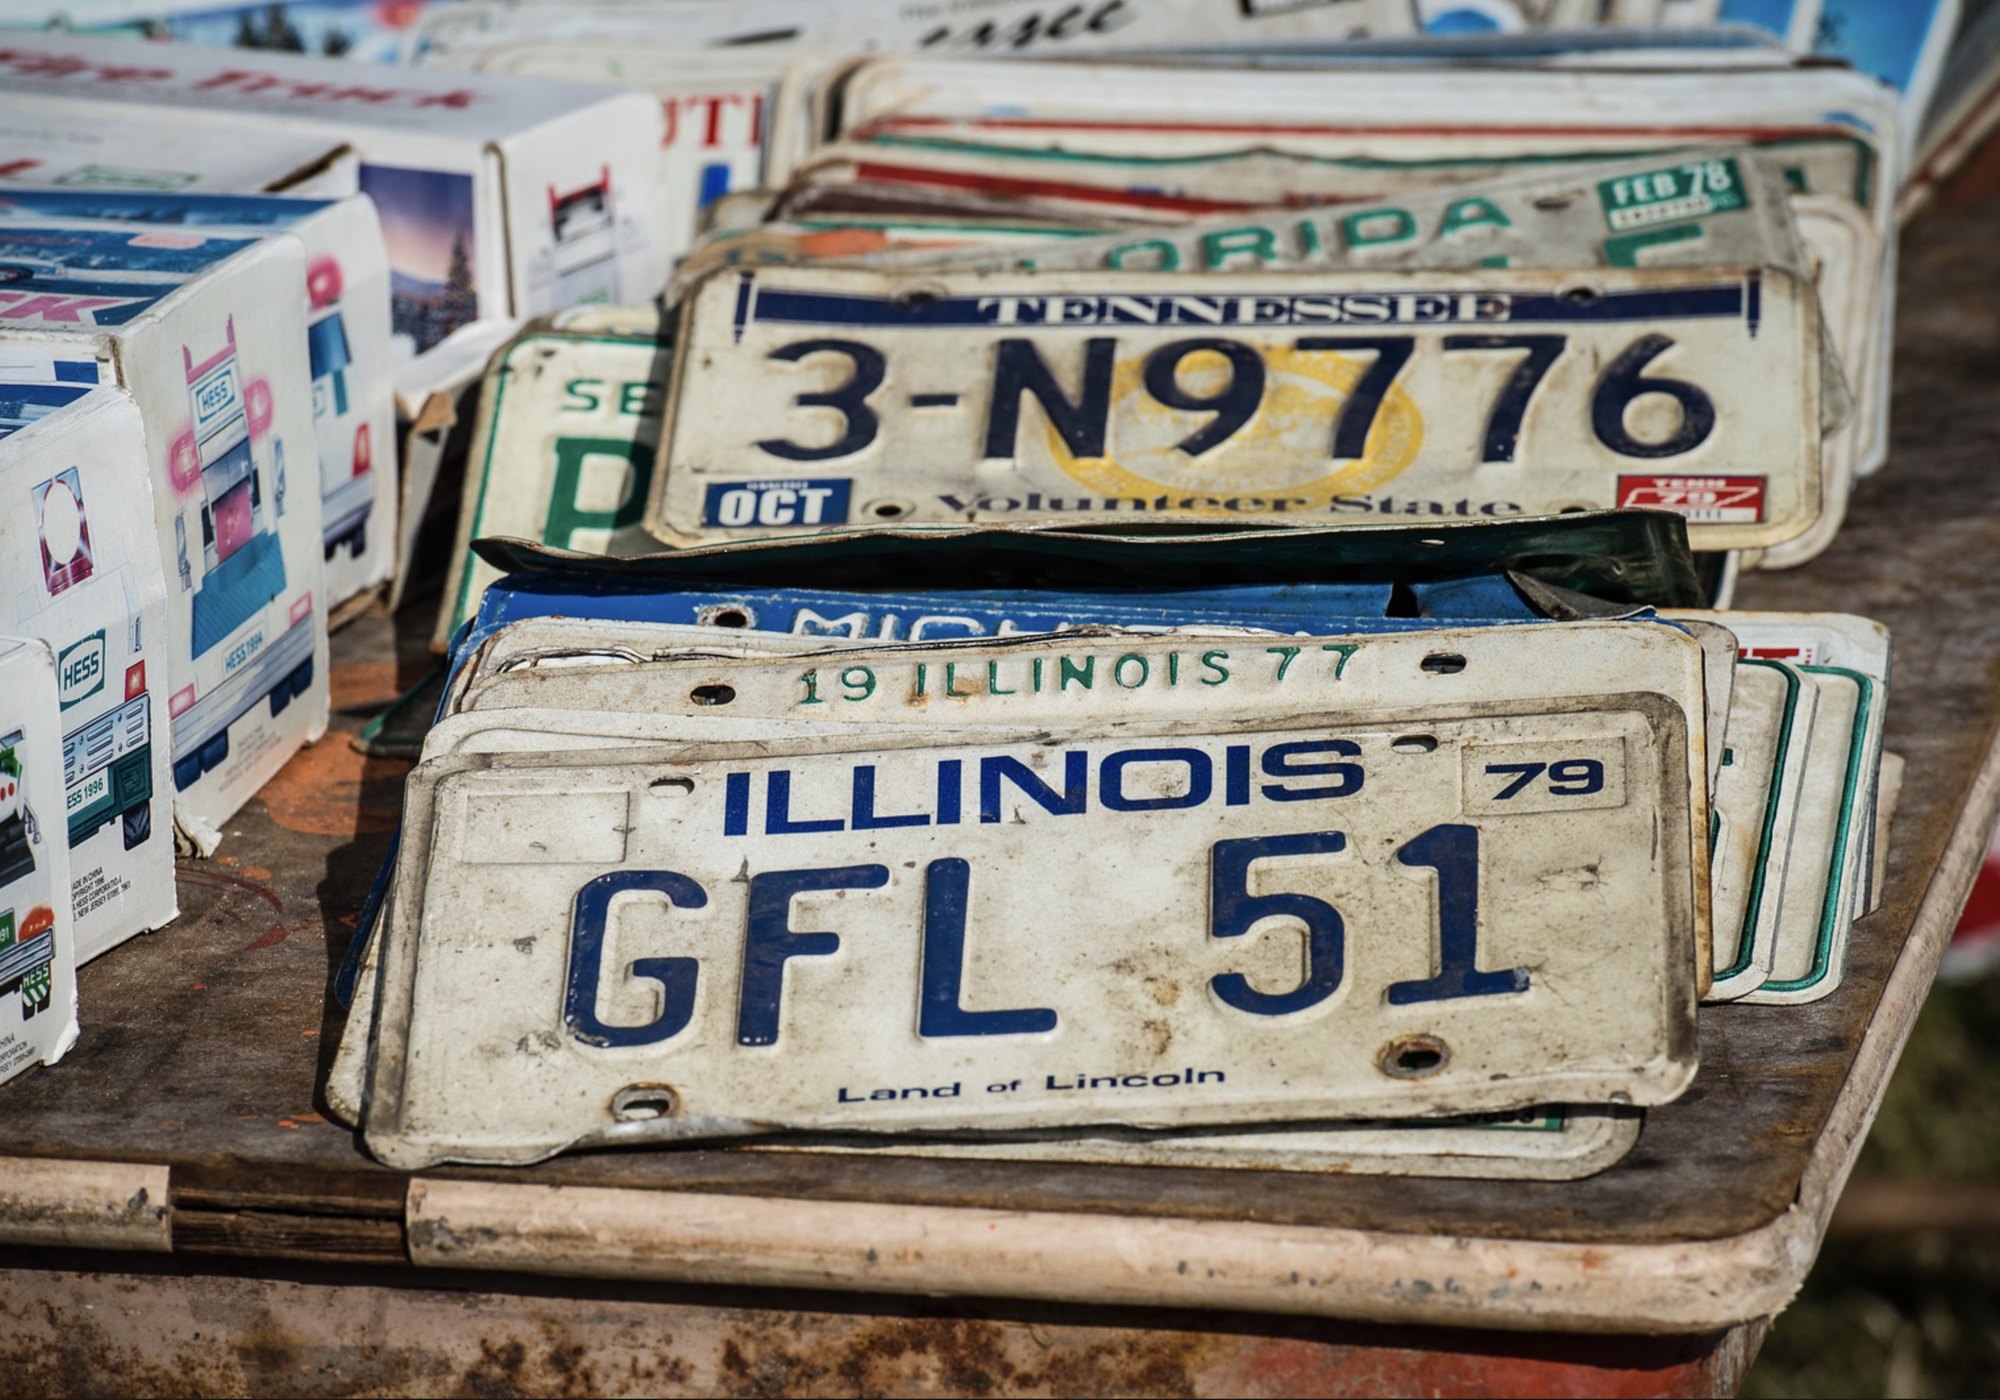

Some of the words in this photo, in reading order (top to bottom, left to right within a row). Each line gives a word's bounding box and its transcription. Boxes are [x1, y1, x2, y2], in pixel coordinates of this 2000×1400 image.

[1612, 172, 1677, 205] FEB
[1680, 159, 1733, 197] 78
[1016, 197, 1513, 272] ORIDA
[977, 293, 1513, 325] TENNESSEE
[201, 380, 229, 412] HESS
[755, 332, 1717, 463] 3-N9776
[1652, 478, 1727, 489] TENN
[718, 488, 834, 527] OCT
[937, 493, 1307, 516] Volunteer
[1329, 492, 1522, 516] State
[64, 650, 100, 691] HESS
[225, 643, 248, 673] HESS
[799, 664, 880, 706] 19
[915, 650, 1231, 699] ILLINOIS
[1265, 643, 1362, 682] 77
[84, 776, 104, 799] 1996
[723, 738, 1366, 838] ILLINOIS
[1484, 758, 1606, 801] 79
[564, 856, 1060, 1049] GFL
[1209, 822, 1532, 1017] 51
[22, 963, 50, 988] HESS
[837, 1082, 962, 1103] Land
[985, 1079, 1022, 1094] of
[1045, 1067, 1226, 1091] Lincoln
